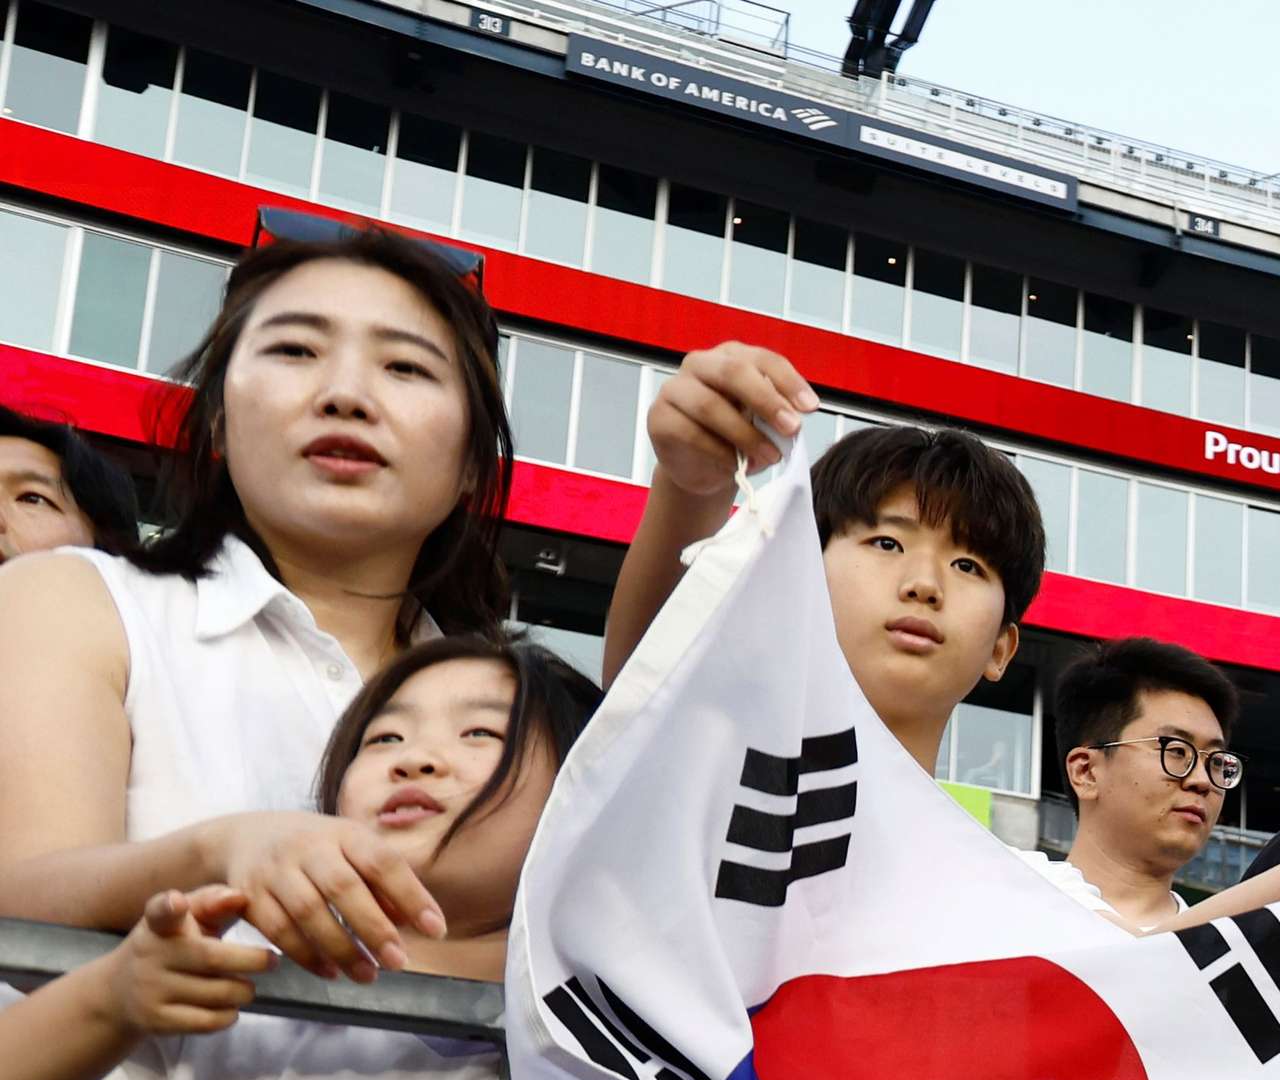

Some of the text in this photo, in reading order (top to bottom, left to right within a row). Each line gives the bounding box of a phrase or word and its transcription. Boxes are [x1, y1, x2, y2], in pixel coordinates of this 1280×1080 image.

[580, 52, 788, 122] BANK OF AMERICA
